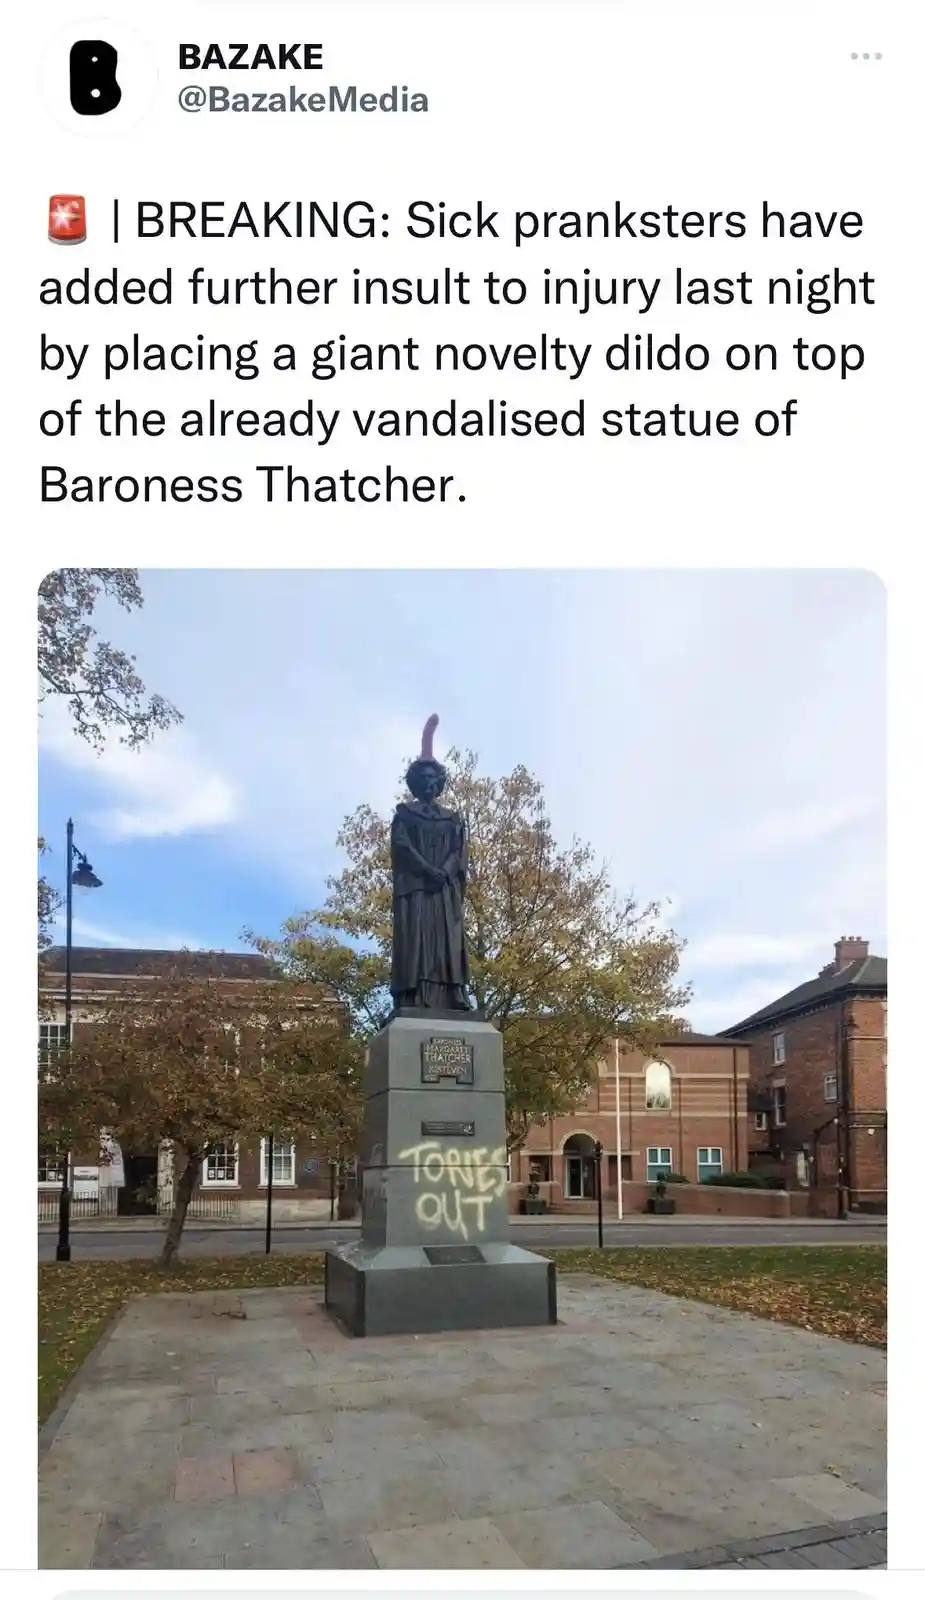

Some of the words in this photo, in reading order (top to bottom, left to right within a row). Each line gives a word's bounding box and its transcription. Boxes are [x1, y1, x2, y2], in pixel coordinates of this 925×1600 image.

[423, 1052, 472, 1064] THATCHER
[398, 1141, 507, 1197] TORIES
[416, 1189, 494, 1241] OUT
